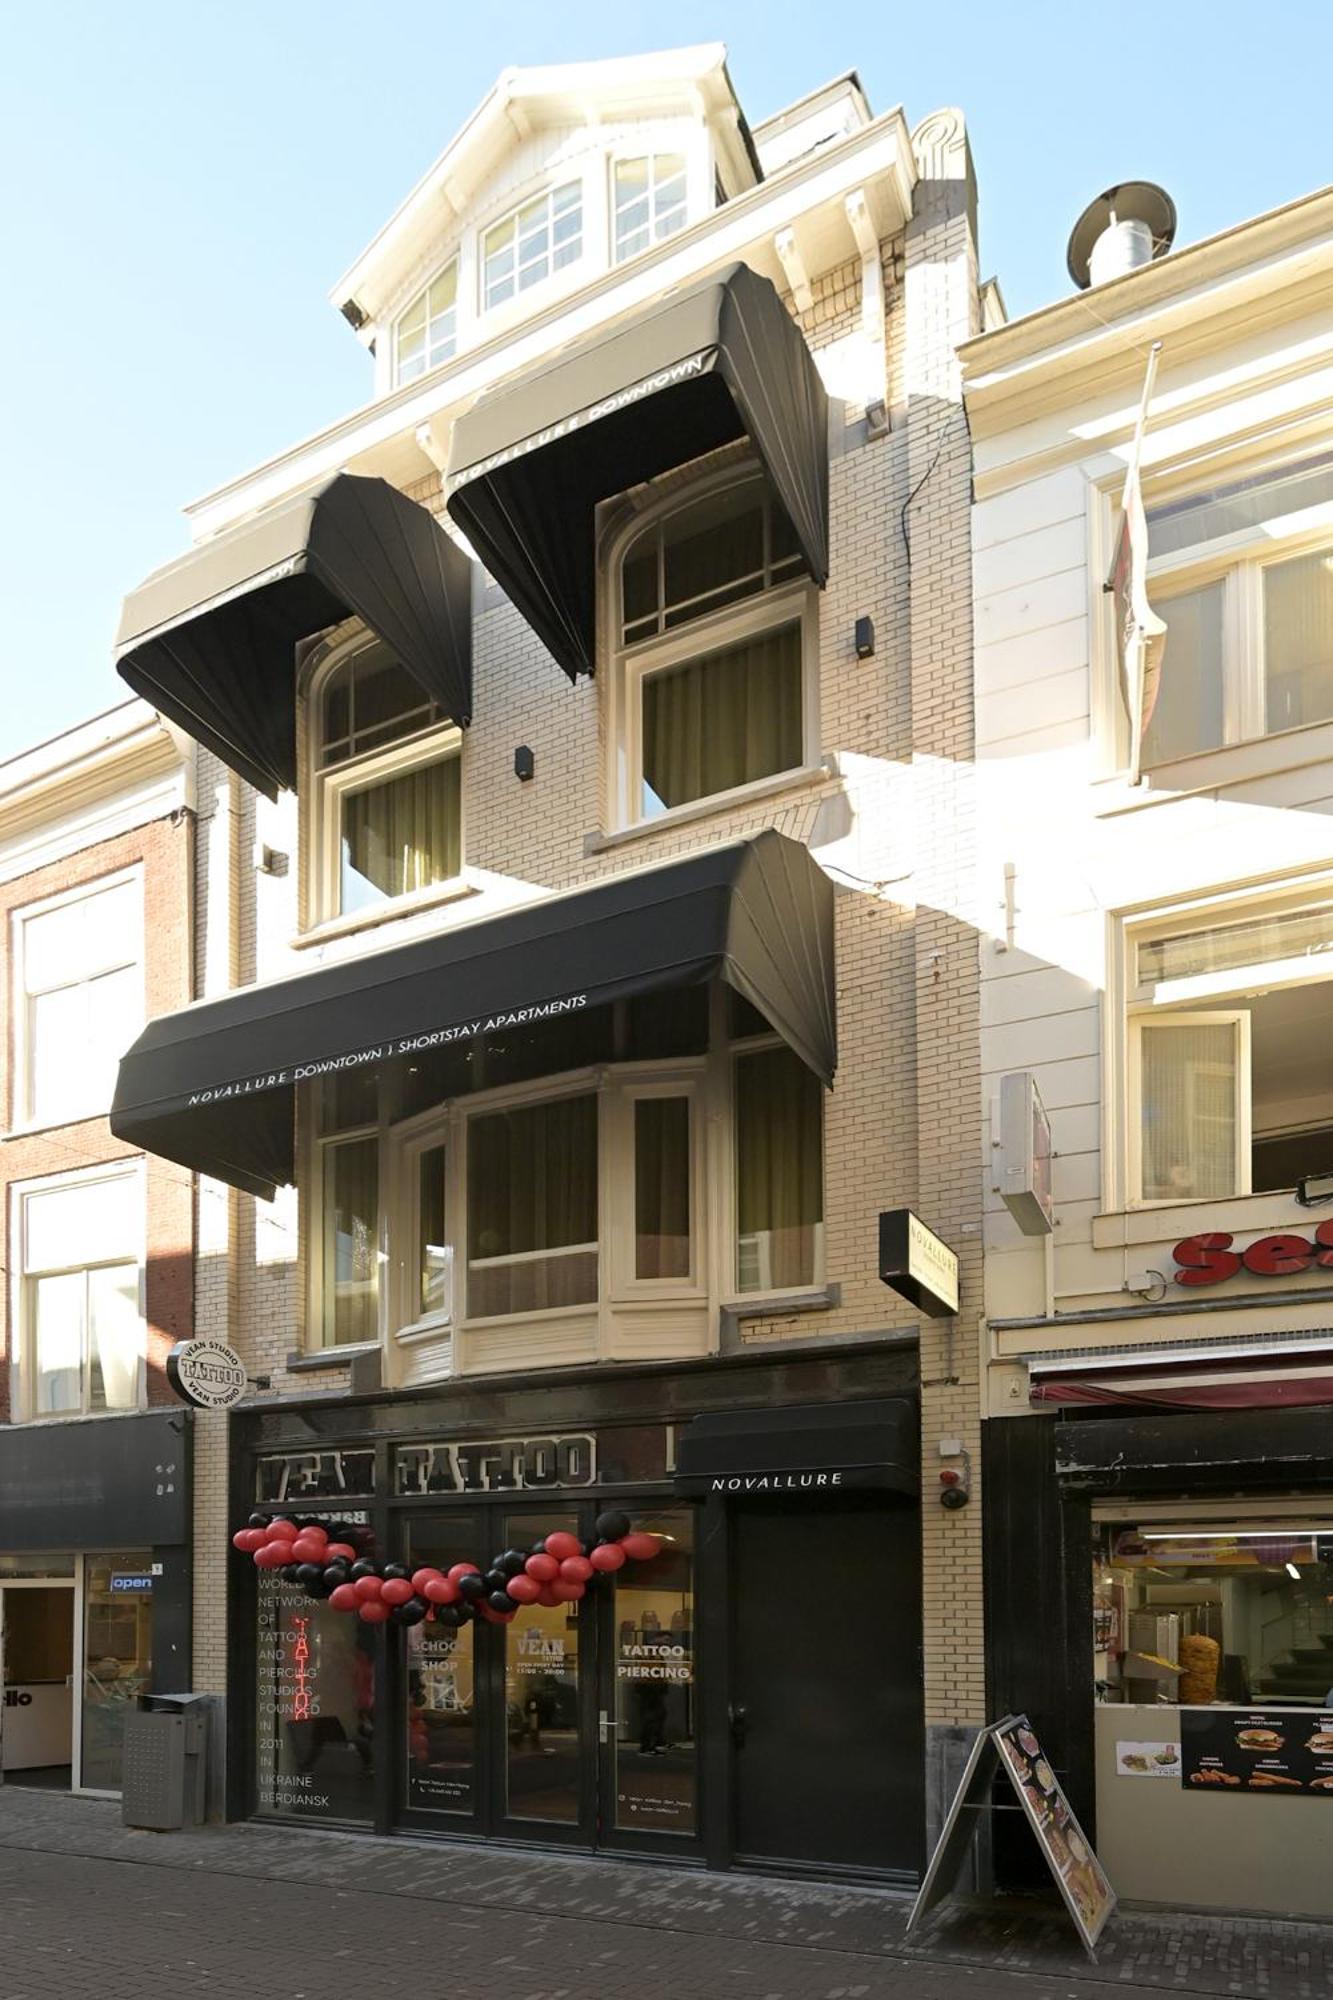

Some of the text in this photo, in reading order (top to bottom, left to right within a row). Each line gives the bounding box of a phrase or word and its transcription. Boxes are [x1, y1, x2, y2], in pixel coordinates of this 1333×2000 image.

[454, 356, 703, 485] NOVALLURE DOWNTOWN
[189, 1072, 288, 1105] NOVALLURE
[294, 1047, 381, 1079] DOWNTOWN
[399, 1022, 481, 1053] SHORTSTAY
[483, 995, 588, 1030] APARTMENTS
[185, 1341, 239, 1366] VEAN STUDIO
[181, 1359, 245, 1387] TATTOO
[188, 1381, 240, 1405] VEAN STUDIO
[396, 1433, 597, 1496] TATTOO
[711, 1472, 842, 1491] NOVALLURE
[113, 1578, 152, 1590] open
[259, 1595, 320, 1607] NETWORK
[258, 1614, 275, 1624] OF
[259, 1631, 307, 1642] TATTOO
[516, 1639, 565, 1656] VEAN
[623, 1645, 685, 1657] TATTOO
[260, 1649, 285, 1660] AND
[421, 1661, 458, 1671] SHOP
[617, 1666, 691, 1679] PIERCING
[260, 1685, 313, 1696] STUDIOS
[260, 1721, 271, 1731] IN
[260, 1738, 284, 1750] 2011
[261, 1774, 312, 1788] UKRAINE
[261, 1791, 329, 1806] BERDIANSK
